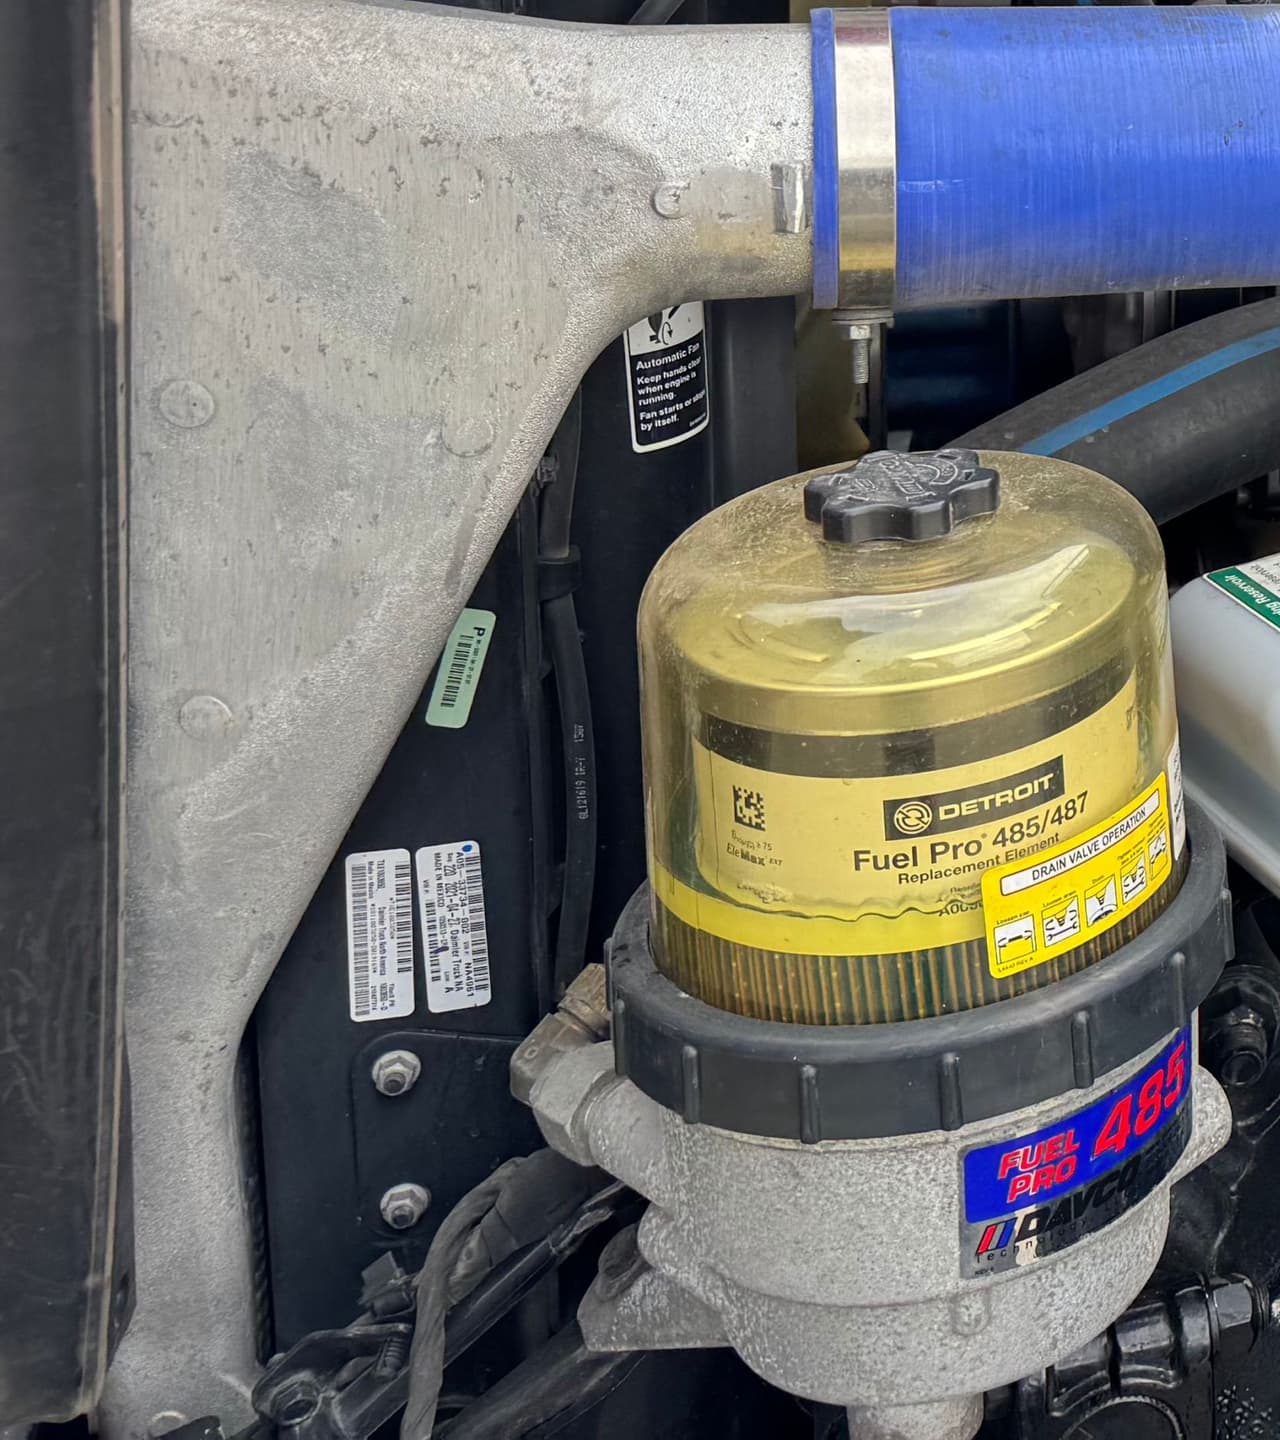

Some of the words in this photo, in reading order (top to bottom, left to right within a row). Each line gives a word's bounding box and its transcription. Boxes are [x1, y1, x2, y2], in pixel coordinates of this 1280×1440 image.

[636, 348, 687, 371] Automatic
[688, 342, 700, 355] Fan
[637, 373, 662, 386] Keep
[663, 365, 687, 379] hands
[638, 383, 664, 395] when
[664, 374, 691, 390] engine
[638, 391, 677, 406] running.
[640, 409, 658, 421] Fan
[659, 401, 684, 416] starts
[640, 422, 653, 432] by
[655, 413, 680, 428] itself.
[1224, 573, 1268, 605] Reservoir
[939, 772, 1055, 821] DETROIT
[853, 846, 919, 872] Fuel
[992, 790, 1090, 848] 485/487
[1032, 857, 1067, 881] DRAIN
[1069, 840, 1100, 866] VALVE
[1102, 806, 1146, 846] OPERATION
[432, 851, 442, 872] MADE
[898, 855, 1001, 885] Replacement
[1004, 832, 1061, 862] Element
[435, 881, 445, 908] MEXICO
[376, 906, 386, 926] Daimler
[377, 926, 386, 941] Truck
[448, 928, 462, 958] Daimler
[377, 940, 387, 954] North
[378, 955, 387, 976] America
[451, 958, 463, 979] Truck
[453, 980, 463, 992] NA
[1089, 1040, 1188, 1162] 485
[997, 1128, 1081, 1180] FUEL
[1006, 1154, 1078, 1204] PRO
